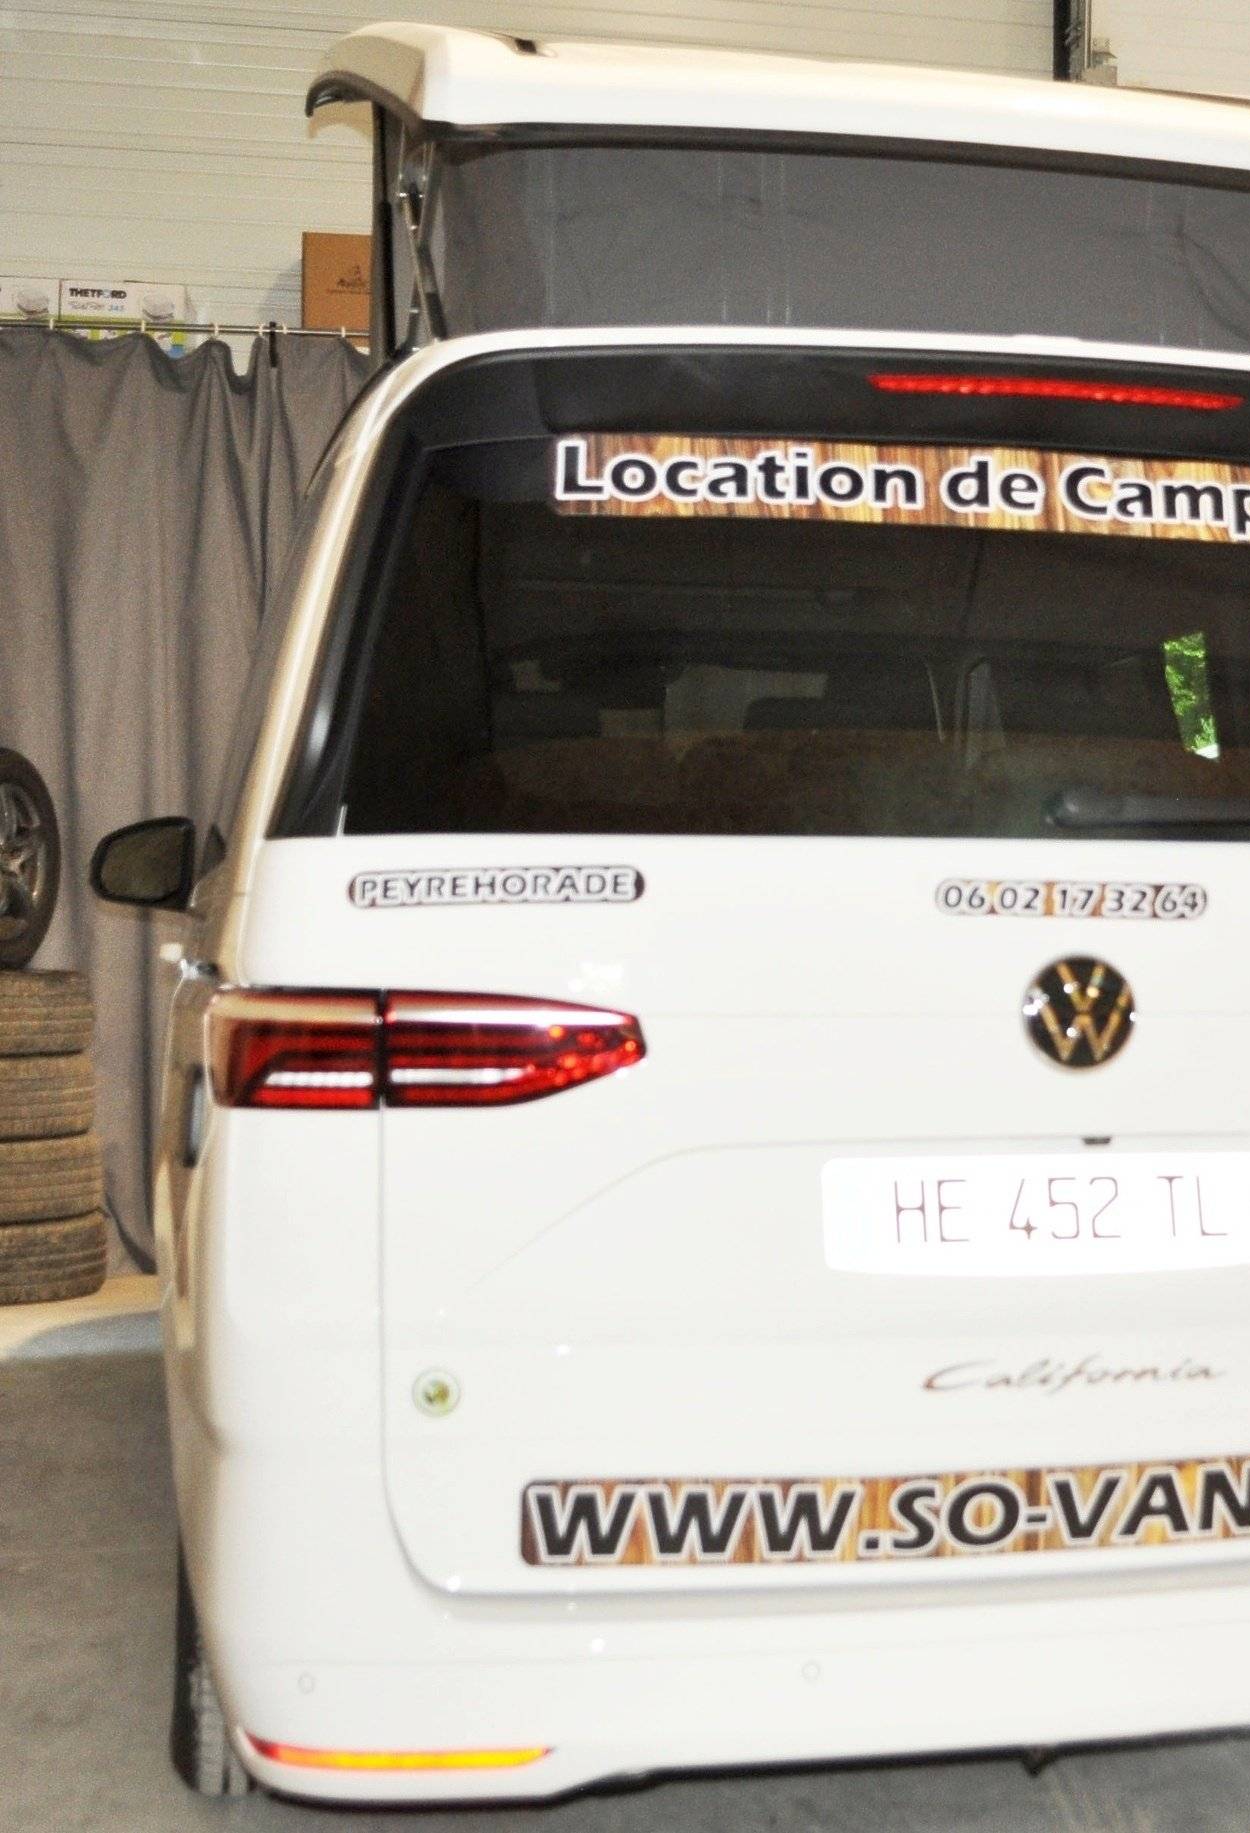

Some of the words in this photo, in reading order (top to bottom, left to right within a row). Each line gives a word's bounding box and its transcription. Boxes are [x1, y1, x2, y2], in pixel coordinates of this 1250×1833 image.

[558, 443, 922, 505] Location
[945, 459, 1039, 511] de
[360, 872, 631, 900] PEYREHORADE
[944, 885, 986, 909] 06
[1000, 887, 1041, 910] 02
[1059, 889, 1095, 911] 17
[1110, 888, 1148, 912] 32
[1161, 890, 1200, 914] 64
[893, 1178, 970, 1243] HE
[1008, 1175, 1122, 1241] 452
[1156, 1175, 1229, 1238] TL
[921, 1353, 1227, 1396] California
